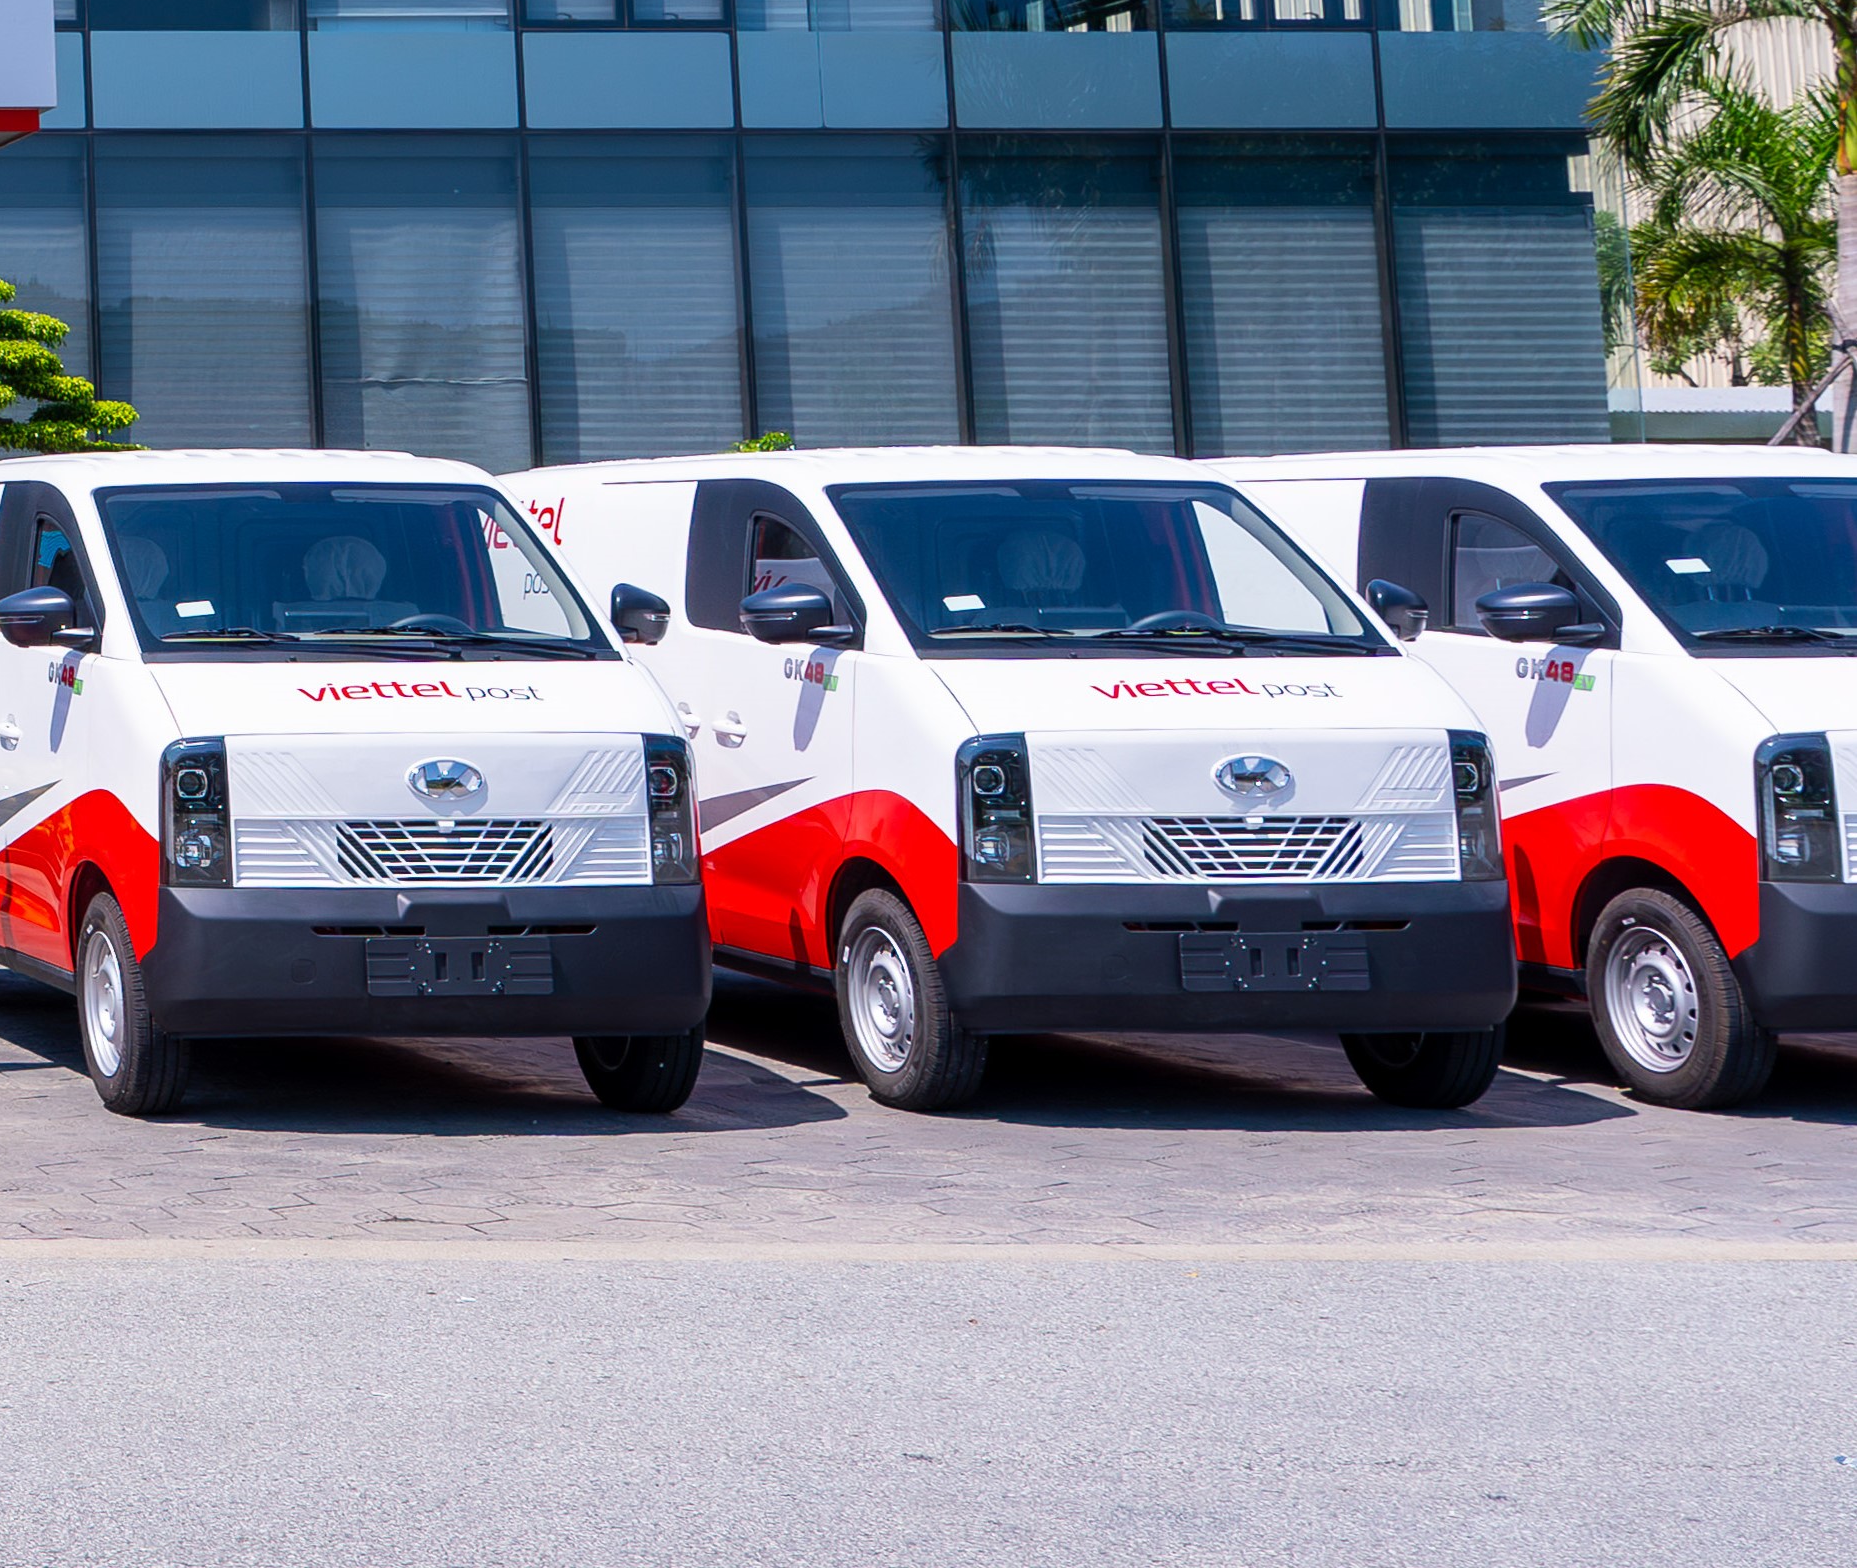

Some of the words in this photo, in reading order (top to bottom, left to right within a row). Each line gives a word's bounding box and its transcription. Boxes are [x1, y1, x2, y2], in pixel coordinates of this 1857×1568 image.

[296, 681, 462, 702] viettel
[465, 686, 544, 702] post
[1090, 678, 1260, 699] viettel
[1261, 683, 1343, 698] post
